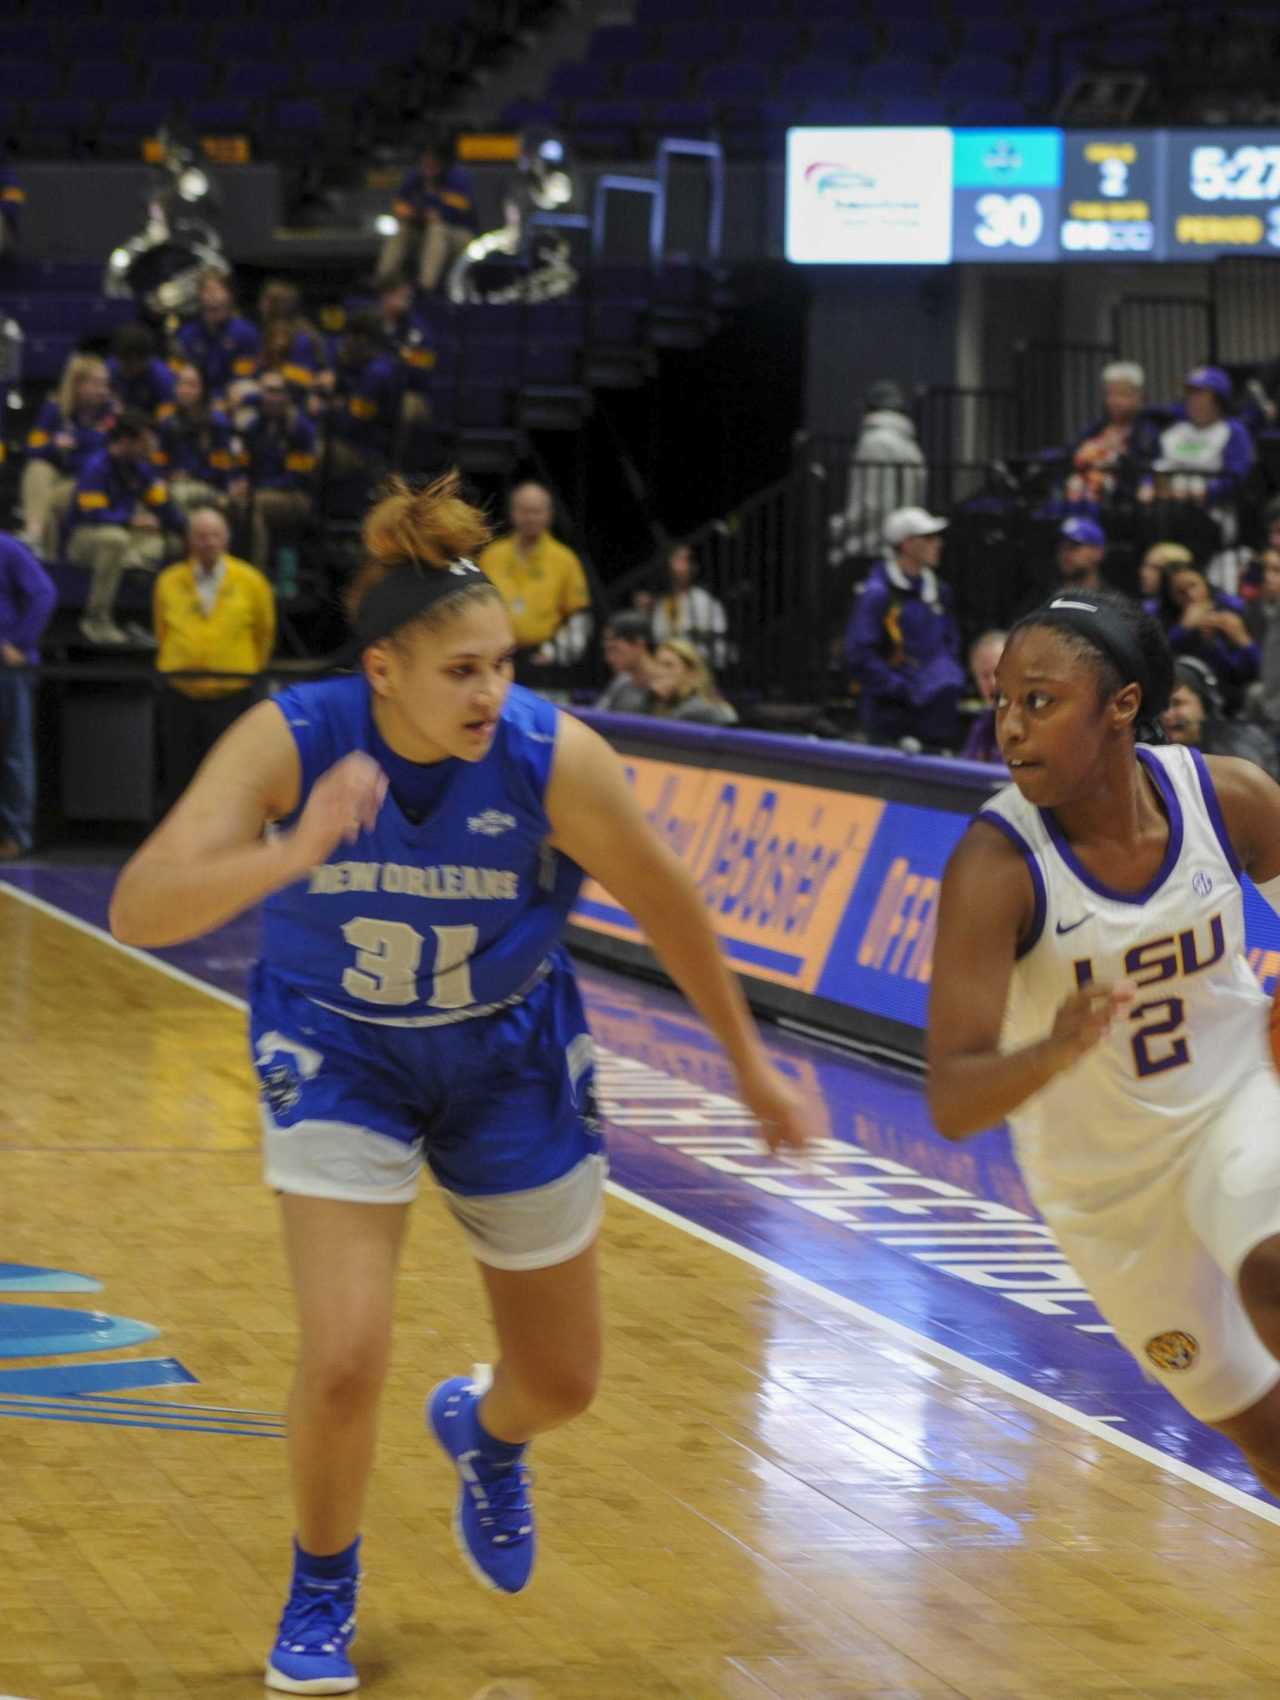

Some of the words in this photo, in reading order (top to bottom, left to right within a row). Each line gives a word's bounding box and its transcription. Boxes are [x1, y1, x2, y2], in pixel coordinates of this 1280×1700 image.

[974, 193, 1043, 247] 30
[307, 861, 380, 894] NEW
[382, 862, 520, 900] ORLEANS
[340, 916, 479, 1010] 31
[1129, 997, 1192, 1080] 2
